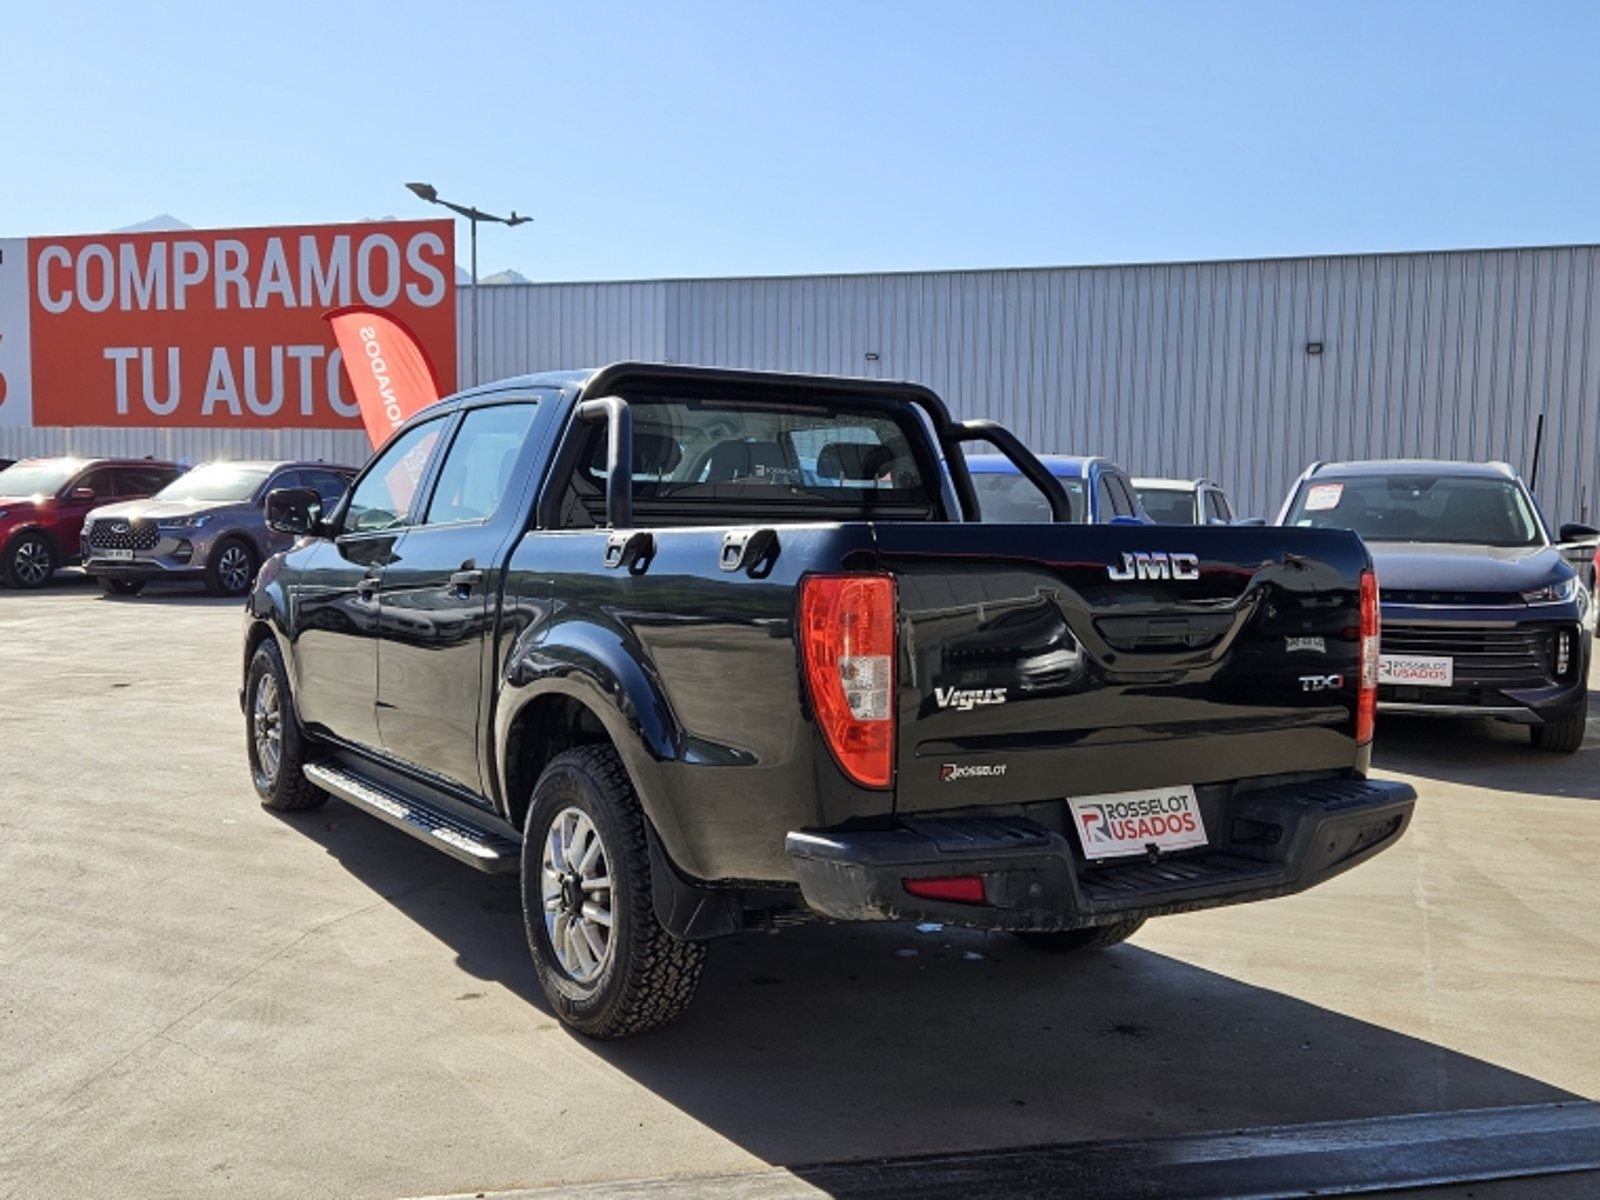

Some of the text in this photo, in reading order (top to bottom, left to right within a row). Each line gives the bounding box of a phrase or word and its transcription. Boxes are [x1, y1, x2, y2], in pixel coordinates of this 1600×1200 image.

[37, 232, 446, 314] COMPRAMOS
[103, 347, 181, 415] TU
[1106, 552, 1200, 580] JMC
[934, 686, 1008, 711] Vigus
[1105, 795, 1189, 820] ROSSELOT
[1111, 812, 1196, 841] USADOS
